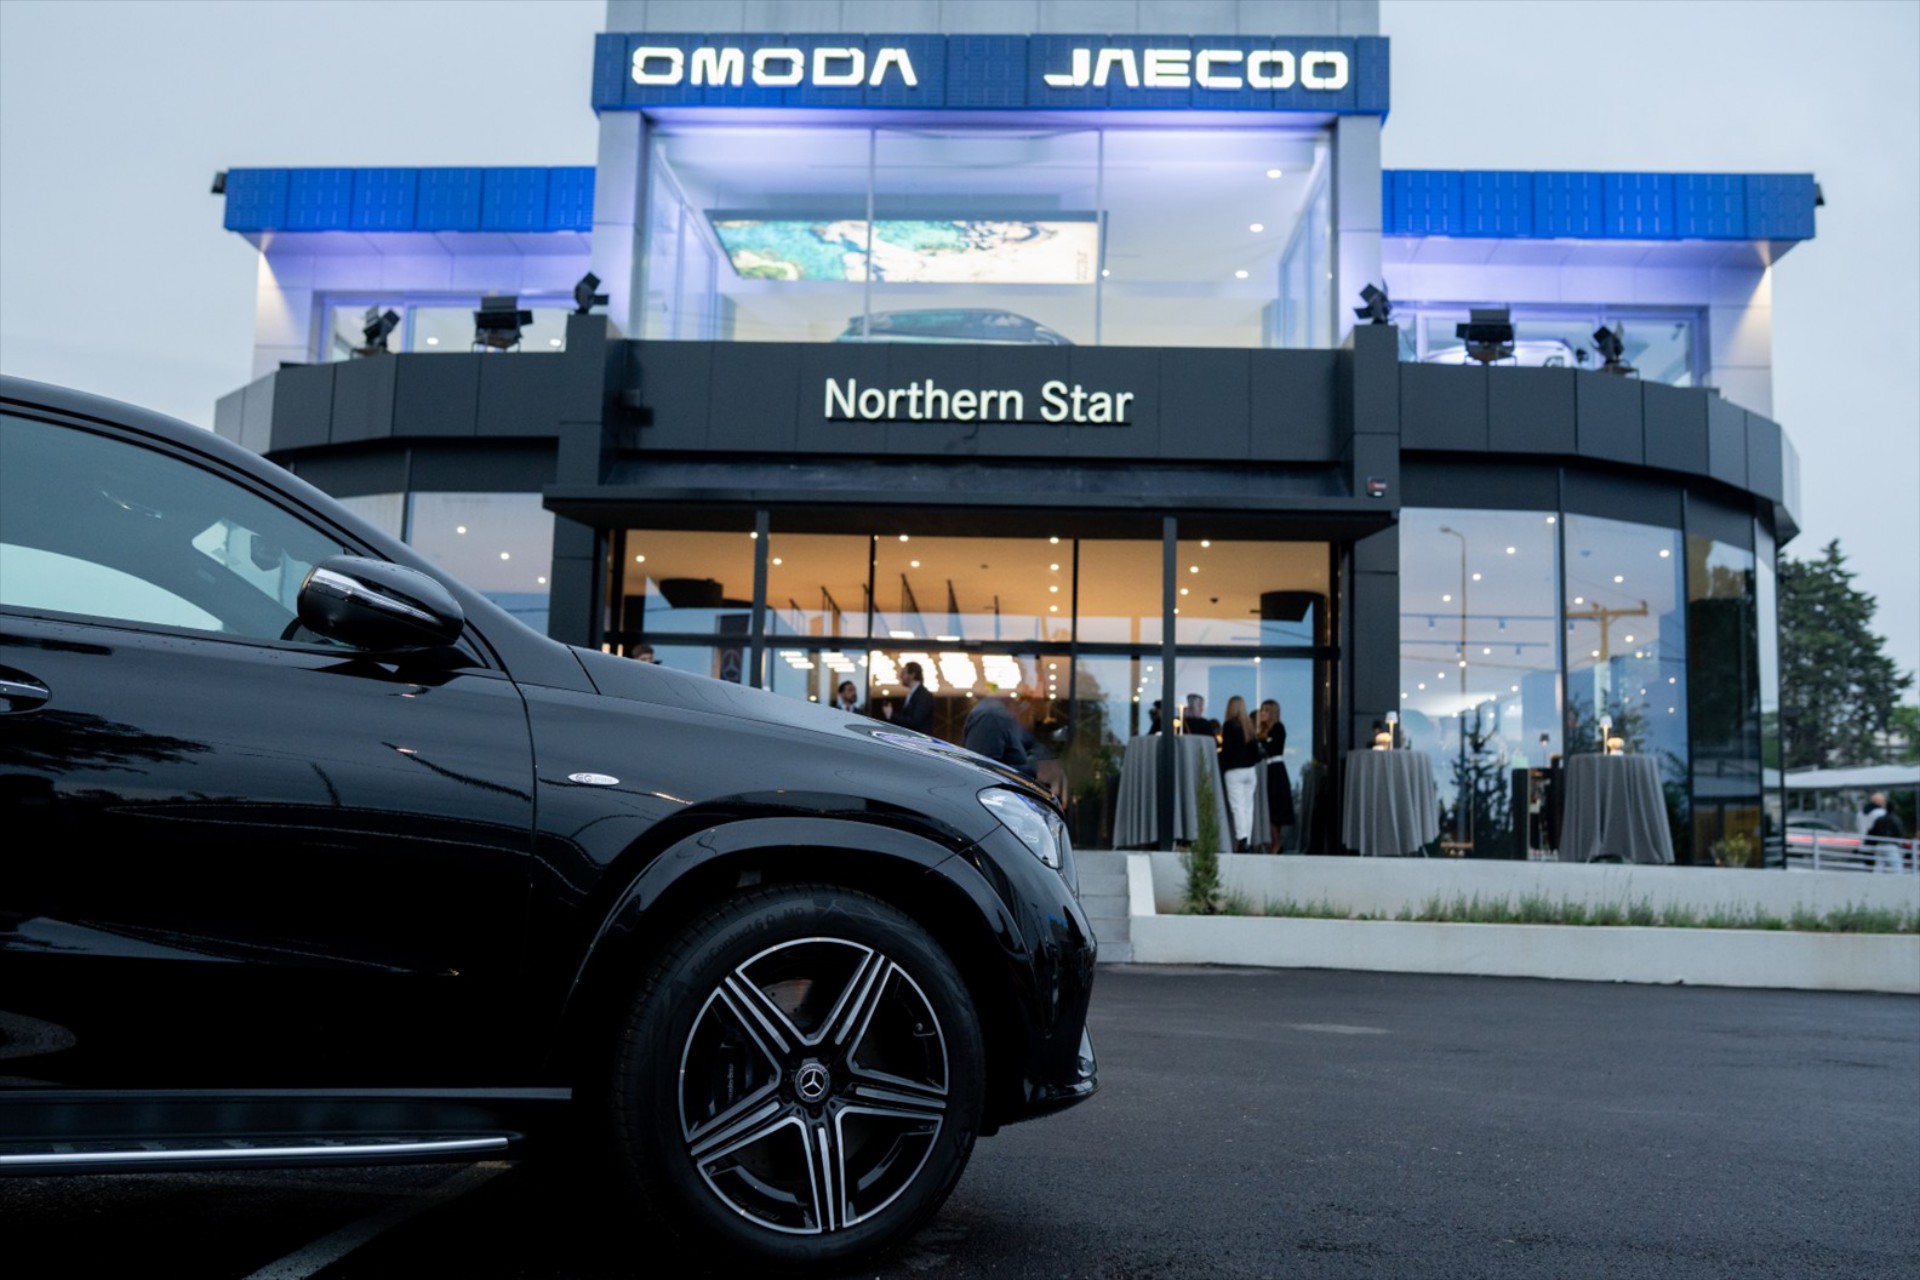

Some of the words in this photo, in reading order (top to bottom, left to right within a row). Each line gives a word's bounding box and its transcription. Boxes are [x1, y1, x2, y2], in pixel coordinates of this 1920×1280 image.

[631, 47, 918, 86] OMODA
[1043, 48, 1349, 89] JAECOO
[824, 378, 1024, 420] Northern
[1040, 380, 1134, 423] Star
